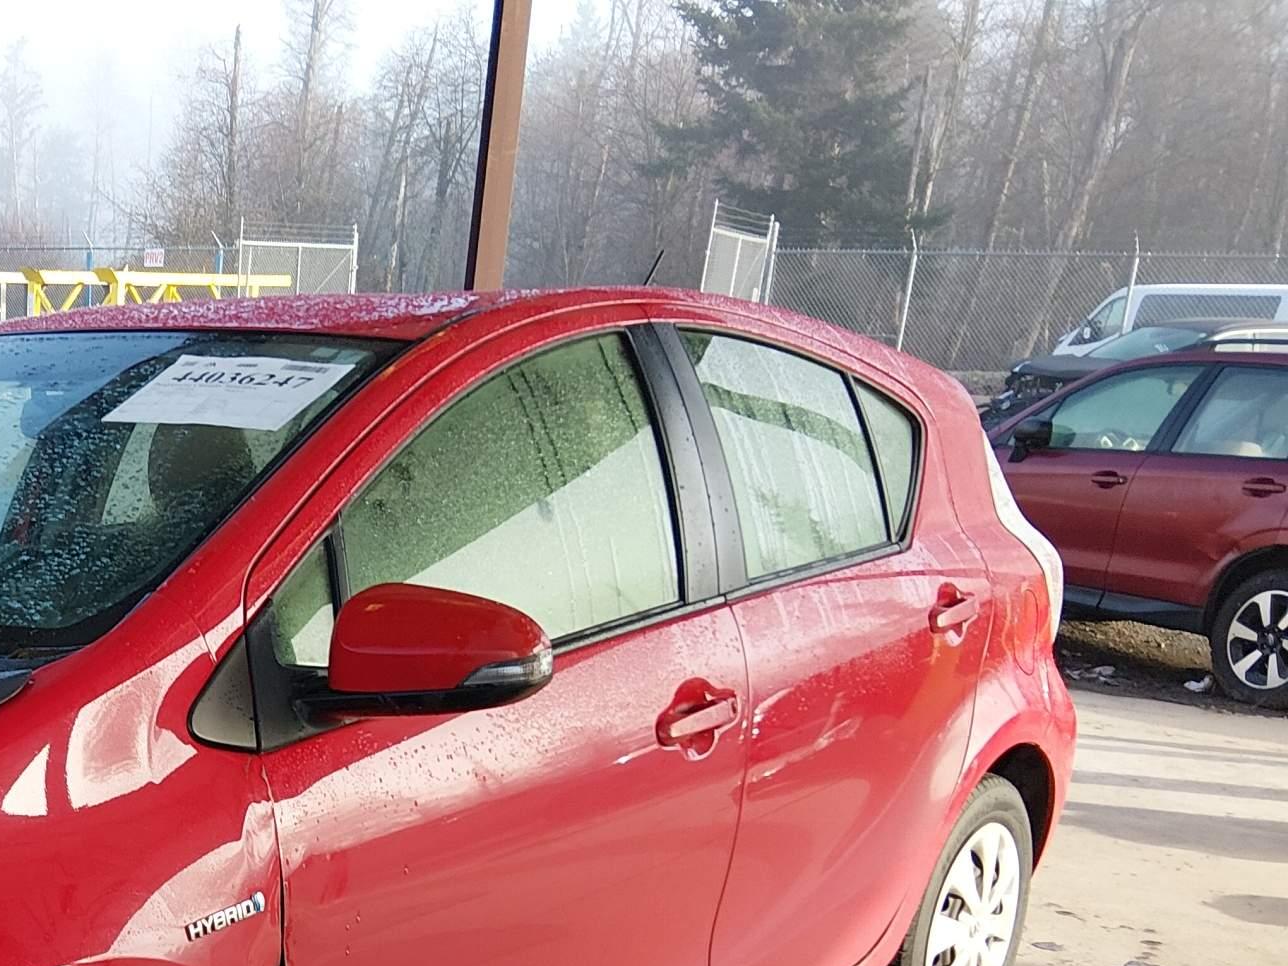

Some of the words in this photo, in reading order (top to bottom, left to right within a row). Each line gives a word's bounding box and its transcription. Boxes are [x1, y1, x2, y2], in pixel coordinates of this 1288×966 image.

[145, 251, 163, 265] PRV2
[172, 371, 314, 388] 44036247
[185, 899, 257, 942] HYBRID
